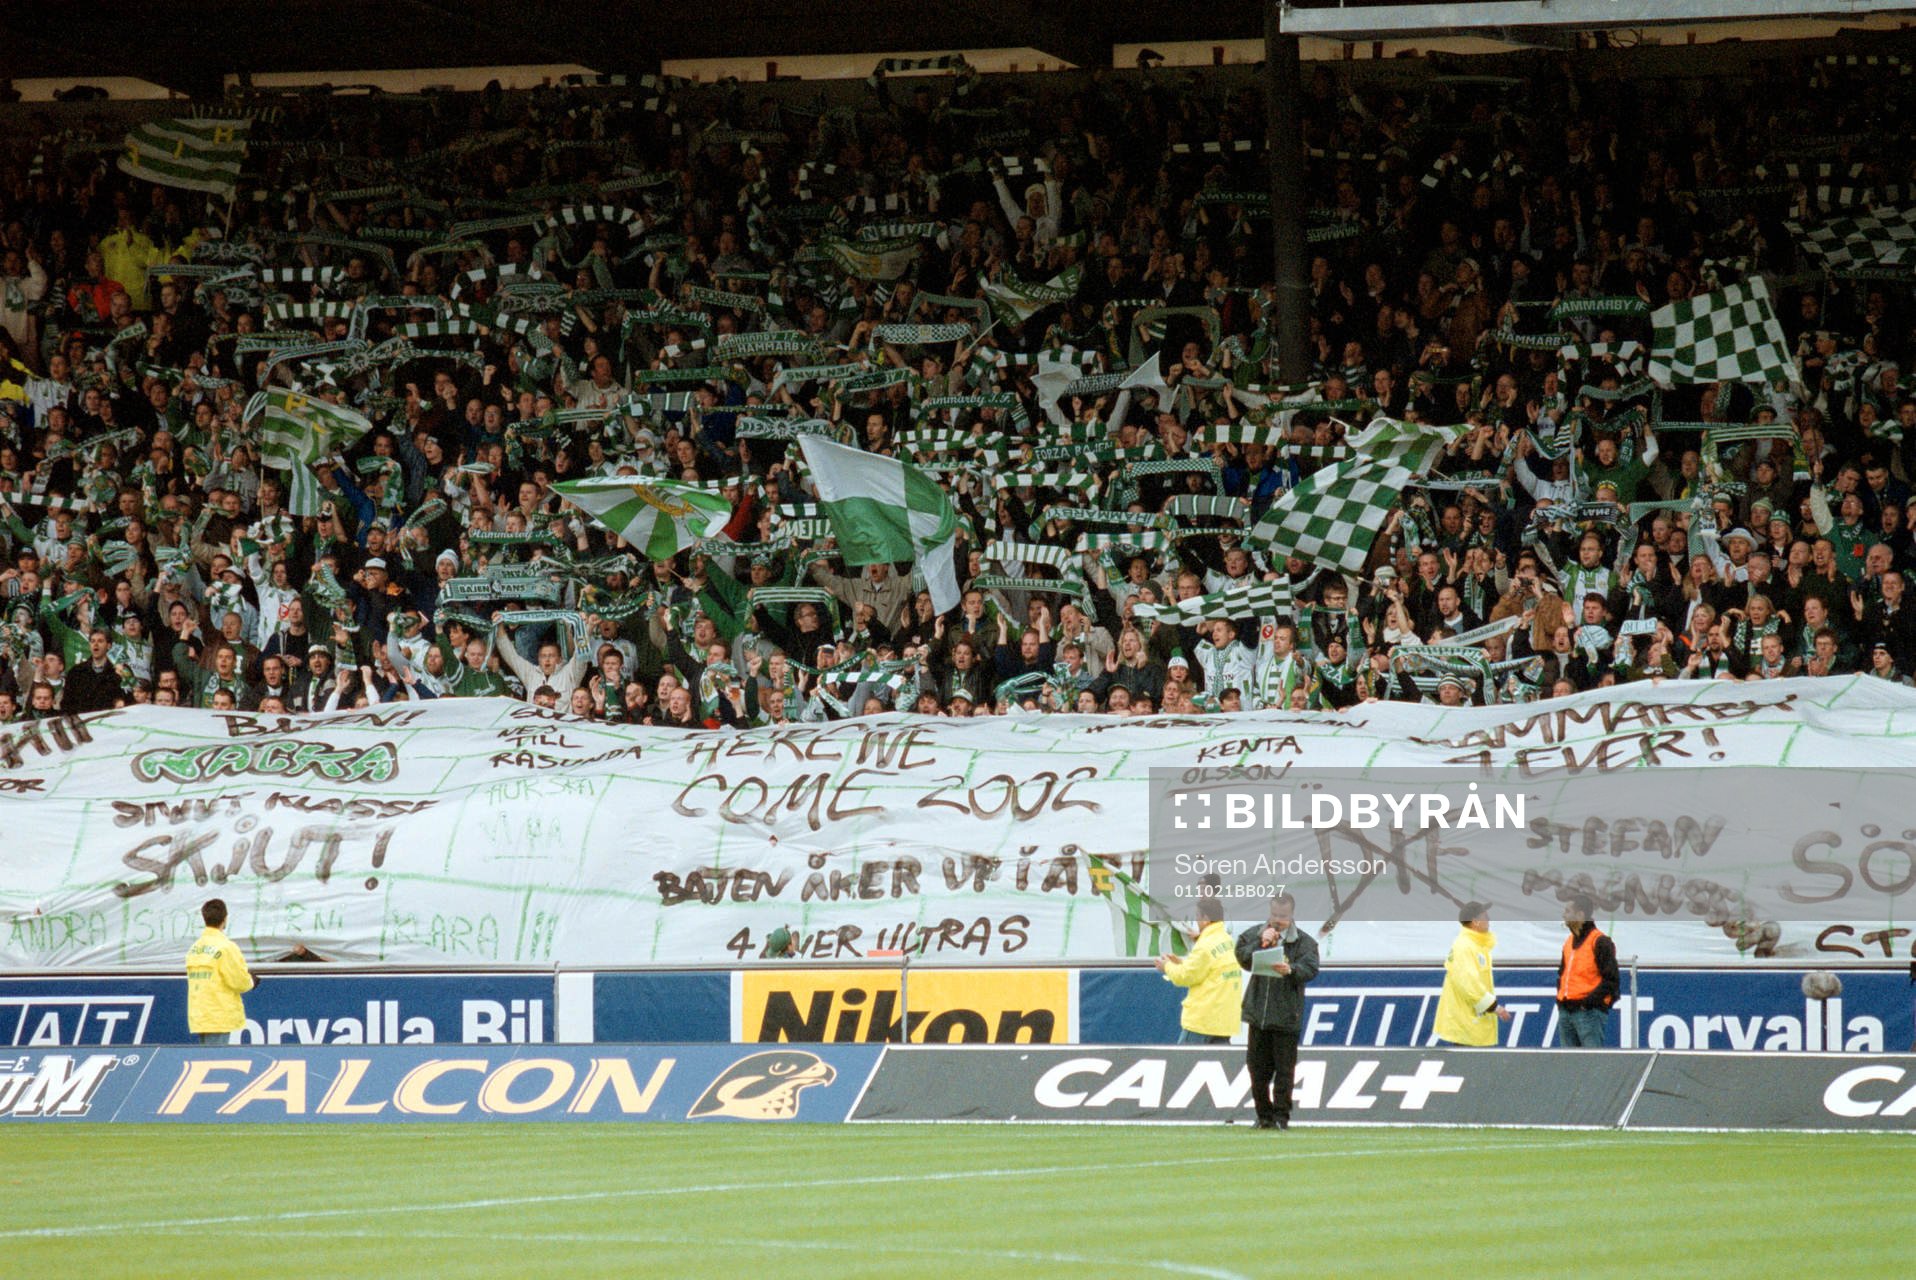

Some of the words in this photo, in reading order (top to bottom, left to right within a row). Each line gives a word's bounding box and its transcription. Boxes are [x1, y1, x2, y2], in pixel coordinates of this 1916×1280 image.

[737, 341, 809, 353] HAMMARBY
[929, 391, 985, 408] ammarby
[1035, 446, 1070, 462] FORZA
[131, 739, 399, 784] NACKA
[1197, 735, 1303, 763] KENTA
[671, 768, 900, 831] COME
[1526, 815, 1727, 859] STEFAN
[875, 916, 1031, 957] ULTRAS
[462, 1000, 544, 1043] Bil
[757, 988, 1056, 1043] Nikon
[1302, 1003, 1541, 1047] FIT
[1612, 995, 1885, 1051] Torvalla
[156, 1058, 676, 1115] FALCON
